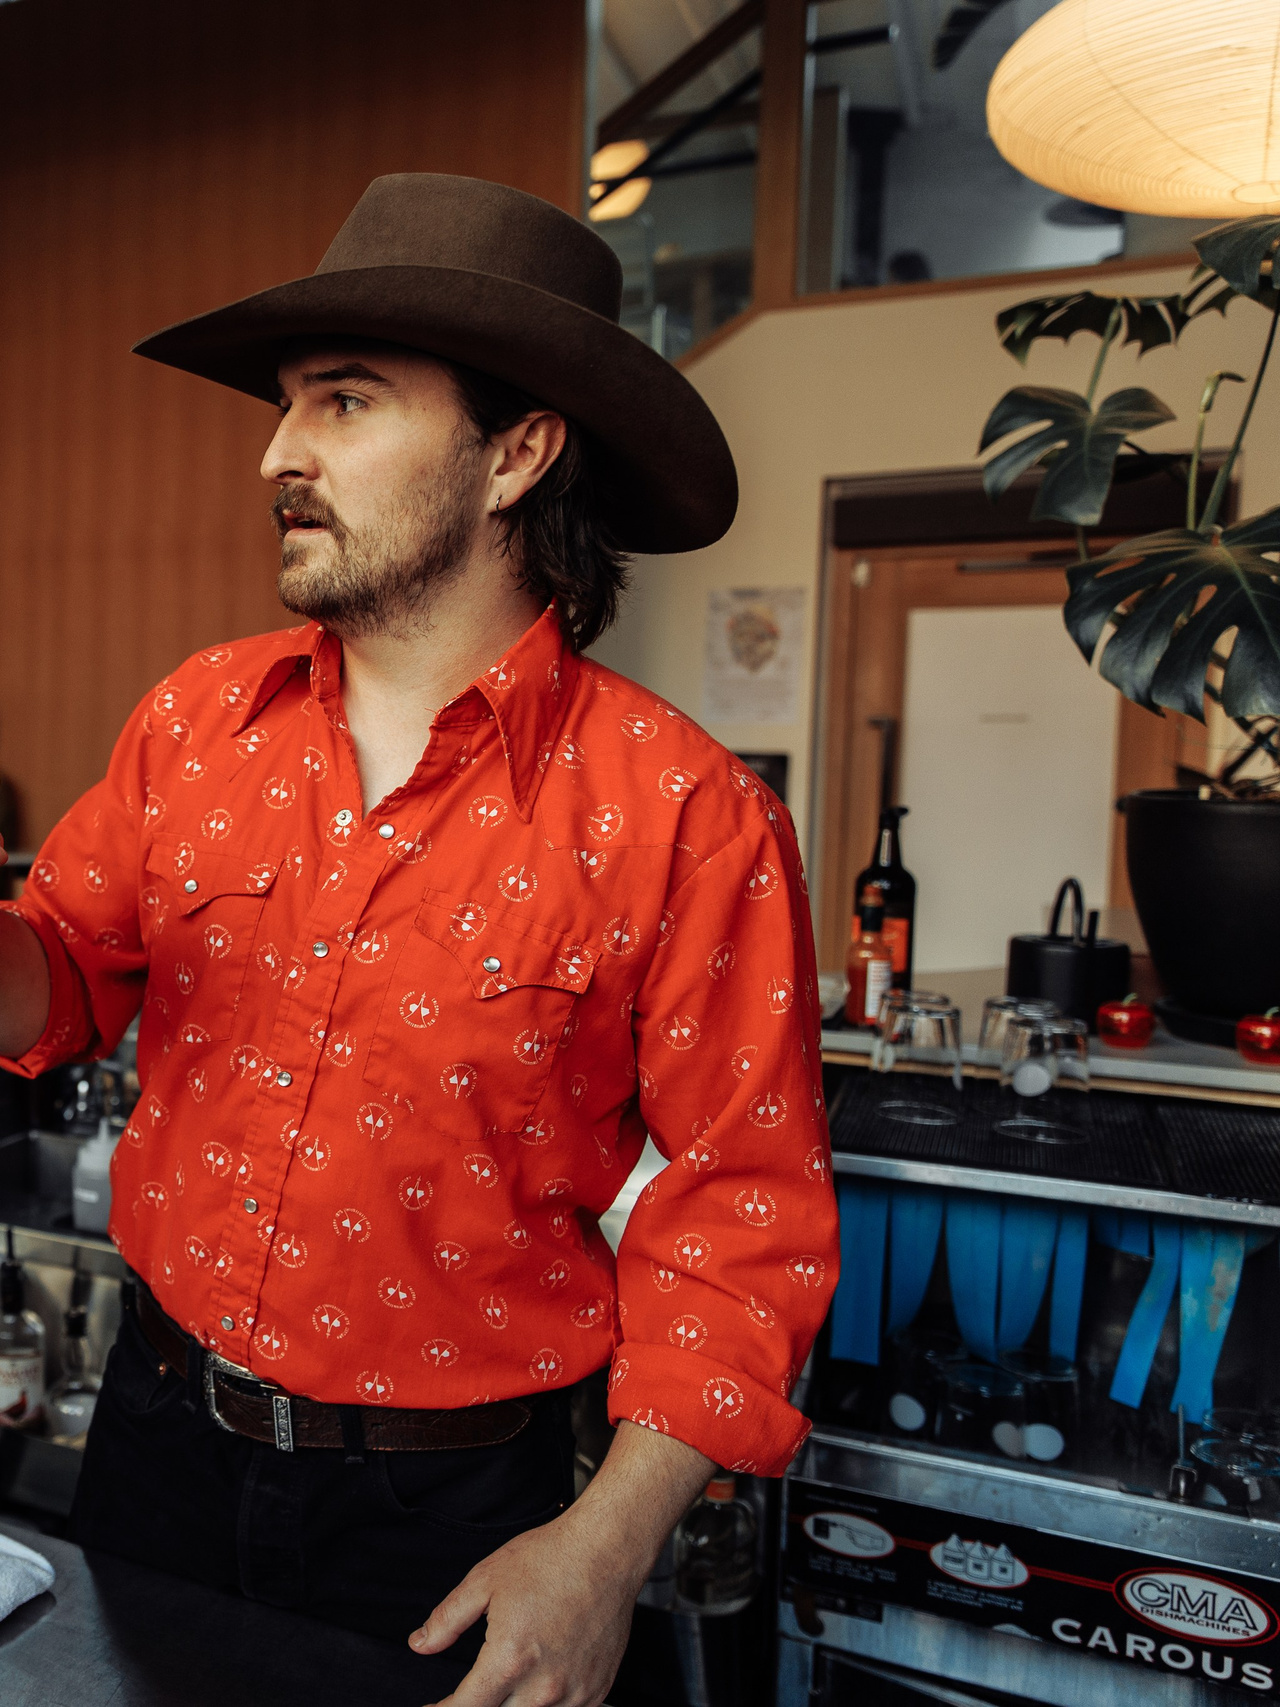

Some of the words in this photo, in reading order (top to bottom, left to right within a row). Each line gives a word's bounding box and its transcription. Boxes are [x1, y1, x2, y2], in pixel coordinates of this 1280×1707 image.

[1130, 1577, 1258, 1631] CMA
[1140, 1606, 1251, 1637] DISHMACHINES
[1051, 1617, 1274, 1690] CAROUS
